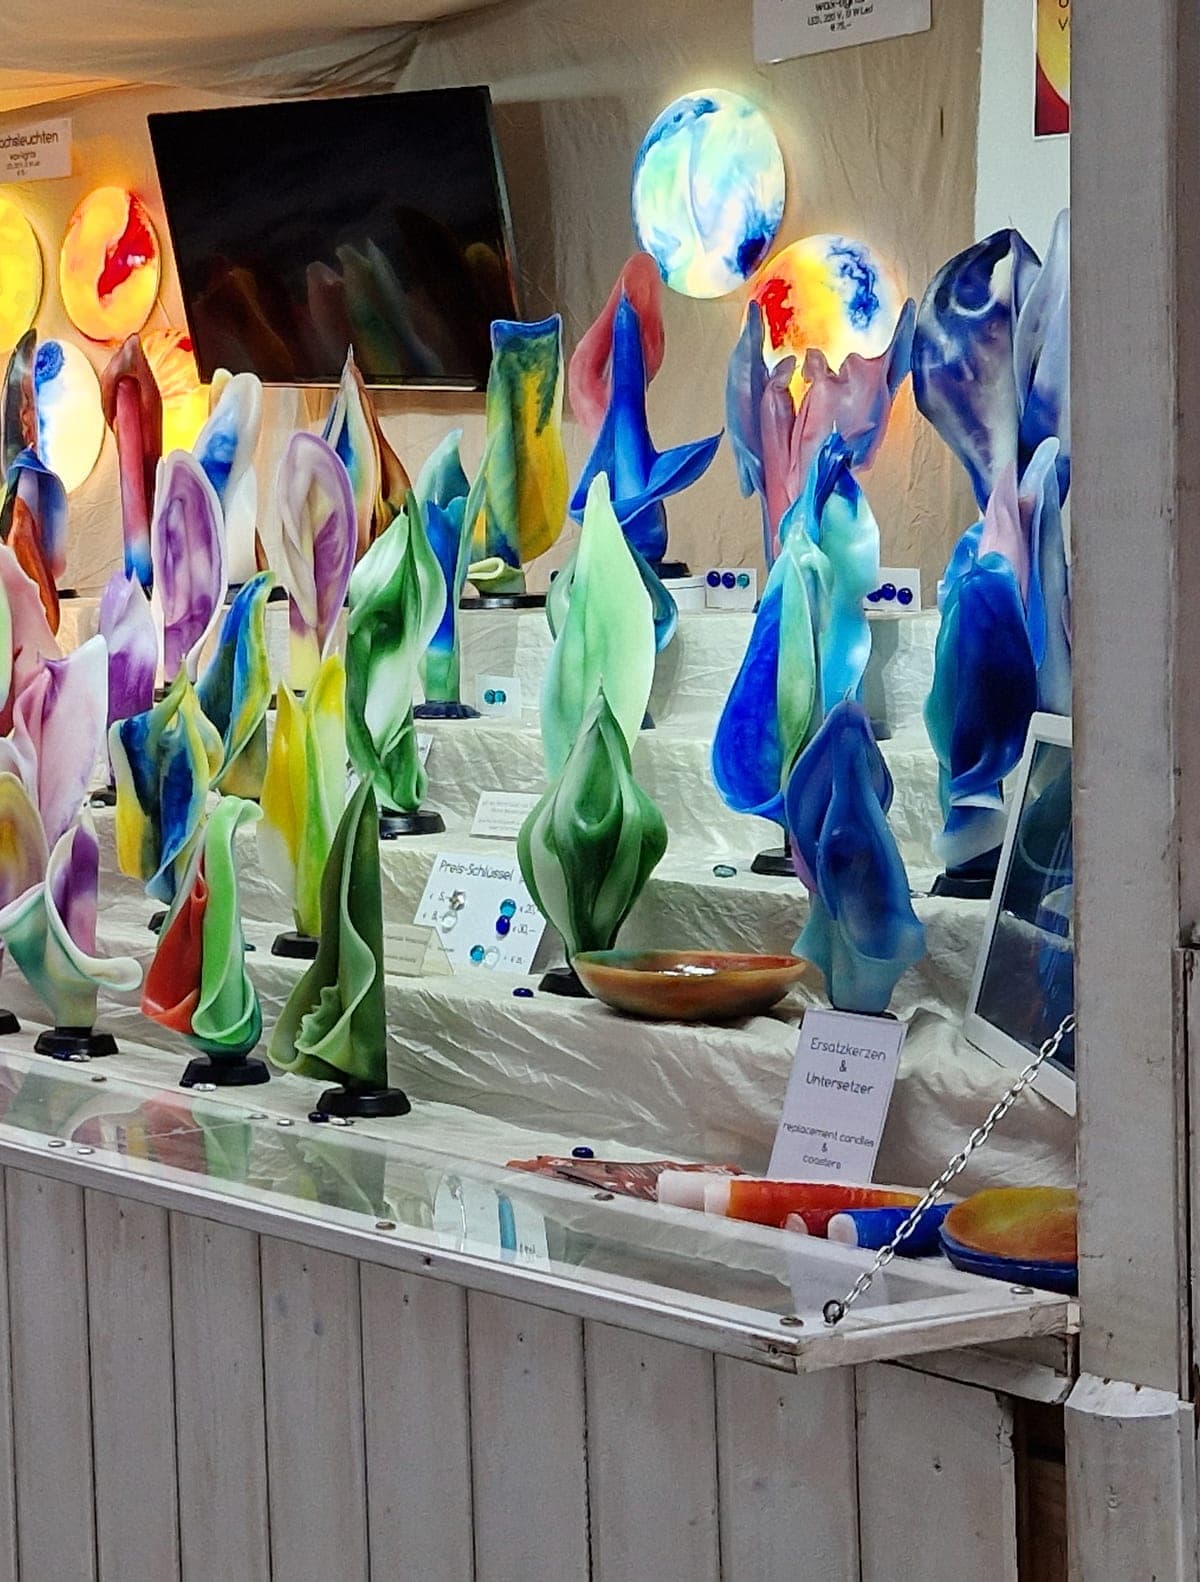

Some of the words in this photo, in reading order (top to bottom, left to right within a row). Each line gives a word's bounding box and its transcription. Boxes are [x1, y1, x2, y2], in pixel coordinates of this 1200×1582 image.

[440, 859, 515, 881] Preis-Schlüssel
[810, 1037, 887, 1061] Ersatzkerzen
[839, 1060, 847, 1073] &
[805, 1071, 875, 1095] Untersetzer
[782, 1120, 838, 1141] replacement
[839, 1132, 875, 1149] candles
[821, 1142, 829, 1153] &
[802, 1153, 842, 1170] coasters
